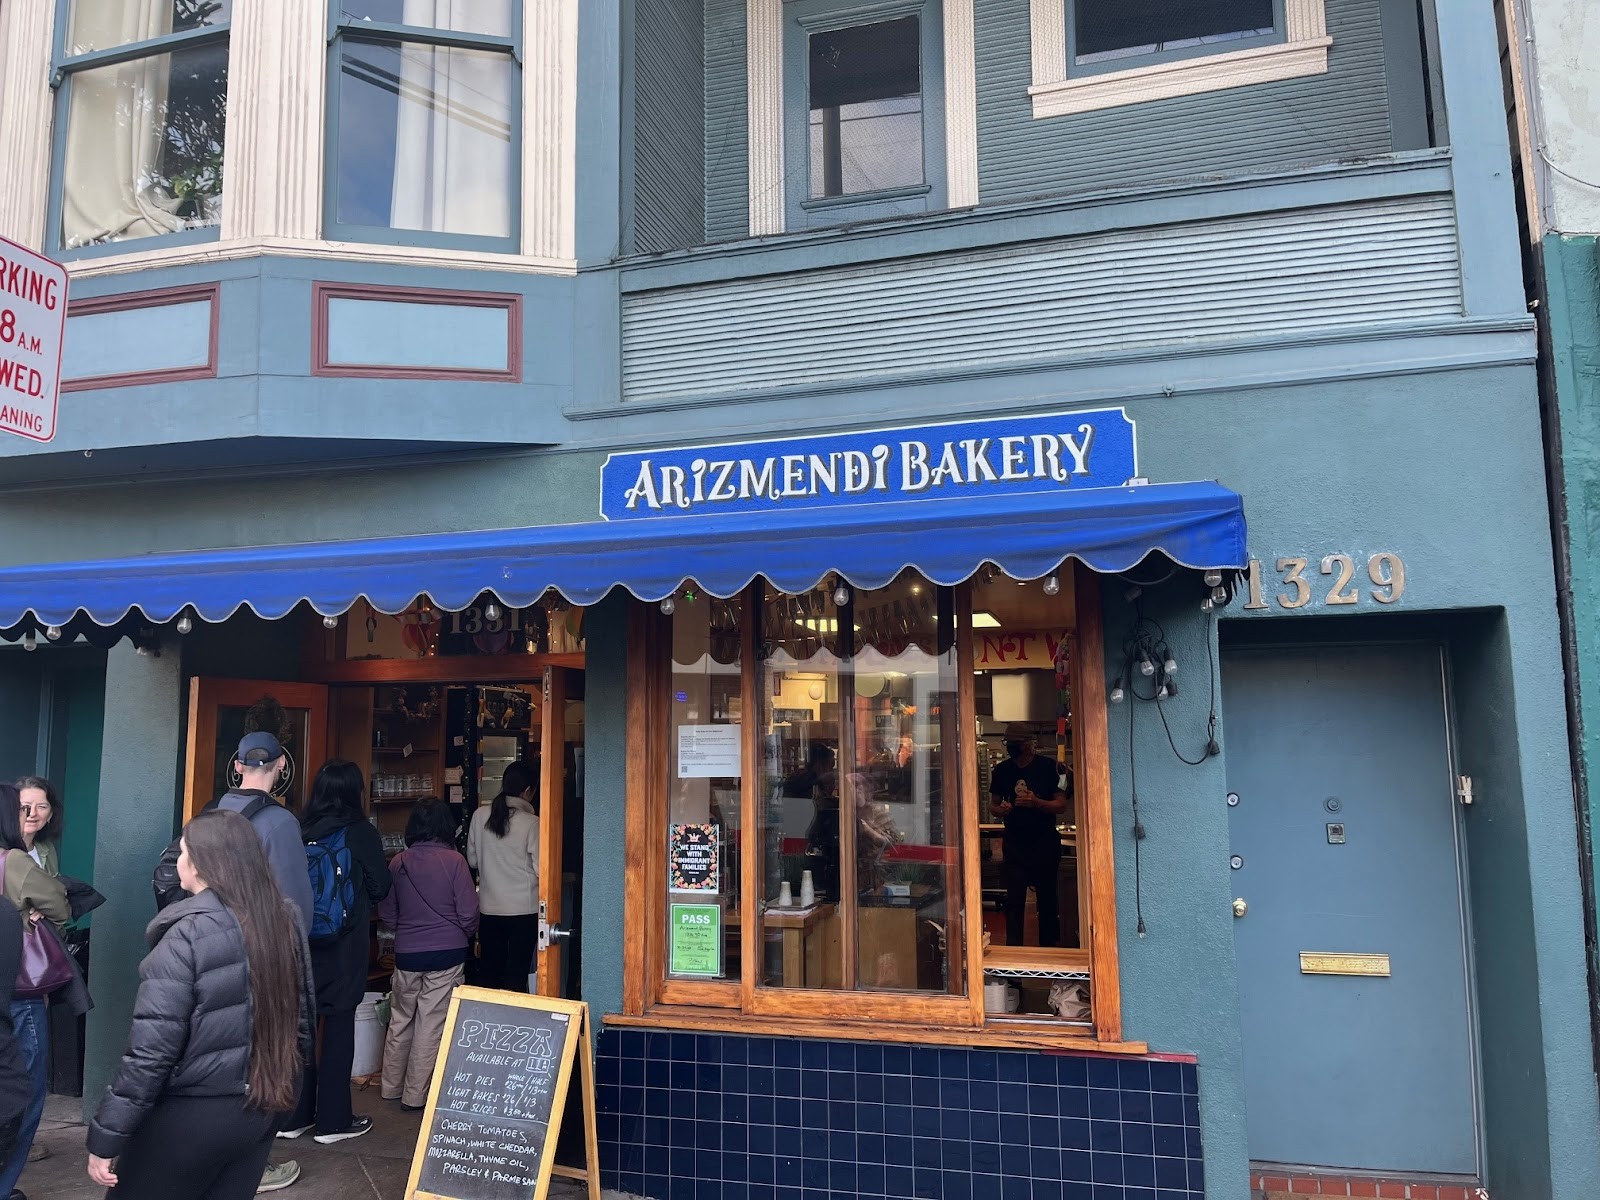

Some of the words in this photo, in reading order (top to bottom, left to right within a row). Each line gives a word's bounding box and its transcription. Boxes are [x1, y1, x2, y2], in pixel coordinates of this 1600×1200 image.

[1, 309, 16, 343] 8
[18, 331, 42, 355] A.M.
[900, 424, 1093, 491] BAKERY
[1244, 552, 1406, 610] 1329
[682, 914, 710, 924] PASS
[458, 1020, 552, 1057] PIZZA
[466, 1052, 513, 1066] AVAILABLE
[511, 1059, 525, 1067] AT
[454, 1071, 472, 1082] HOT
[475, 1075, 496, 1086] PIES
[447, 1086, 471, 1098] LIGHT
[472, 1090, 500, 1102] BAKES
[450, 1100, 468, 1110] HOT
[470, 1104, 497, 1114] SLICES
[441, 1119, 473, 1131] CHERRY
[478, 1124, 527, 1143] TOMATOES,
[499, 1143, 537, 1157] CHEDDAR,
[478, 1155, 508, 1165] THYME
[509, 1160, 529, 1171] OIL,
[443, 1162, 482, 1176] PARSLEY
[492, 1171, 538, 1186] PARMESAN
